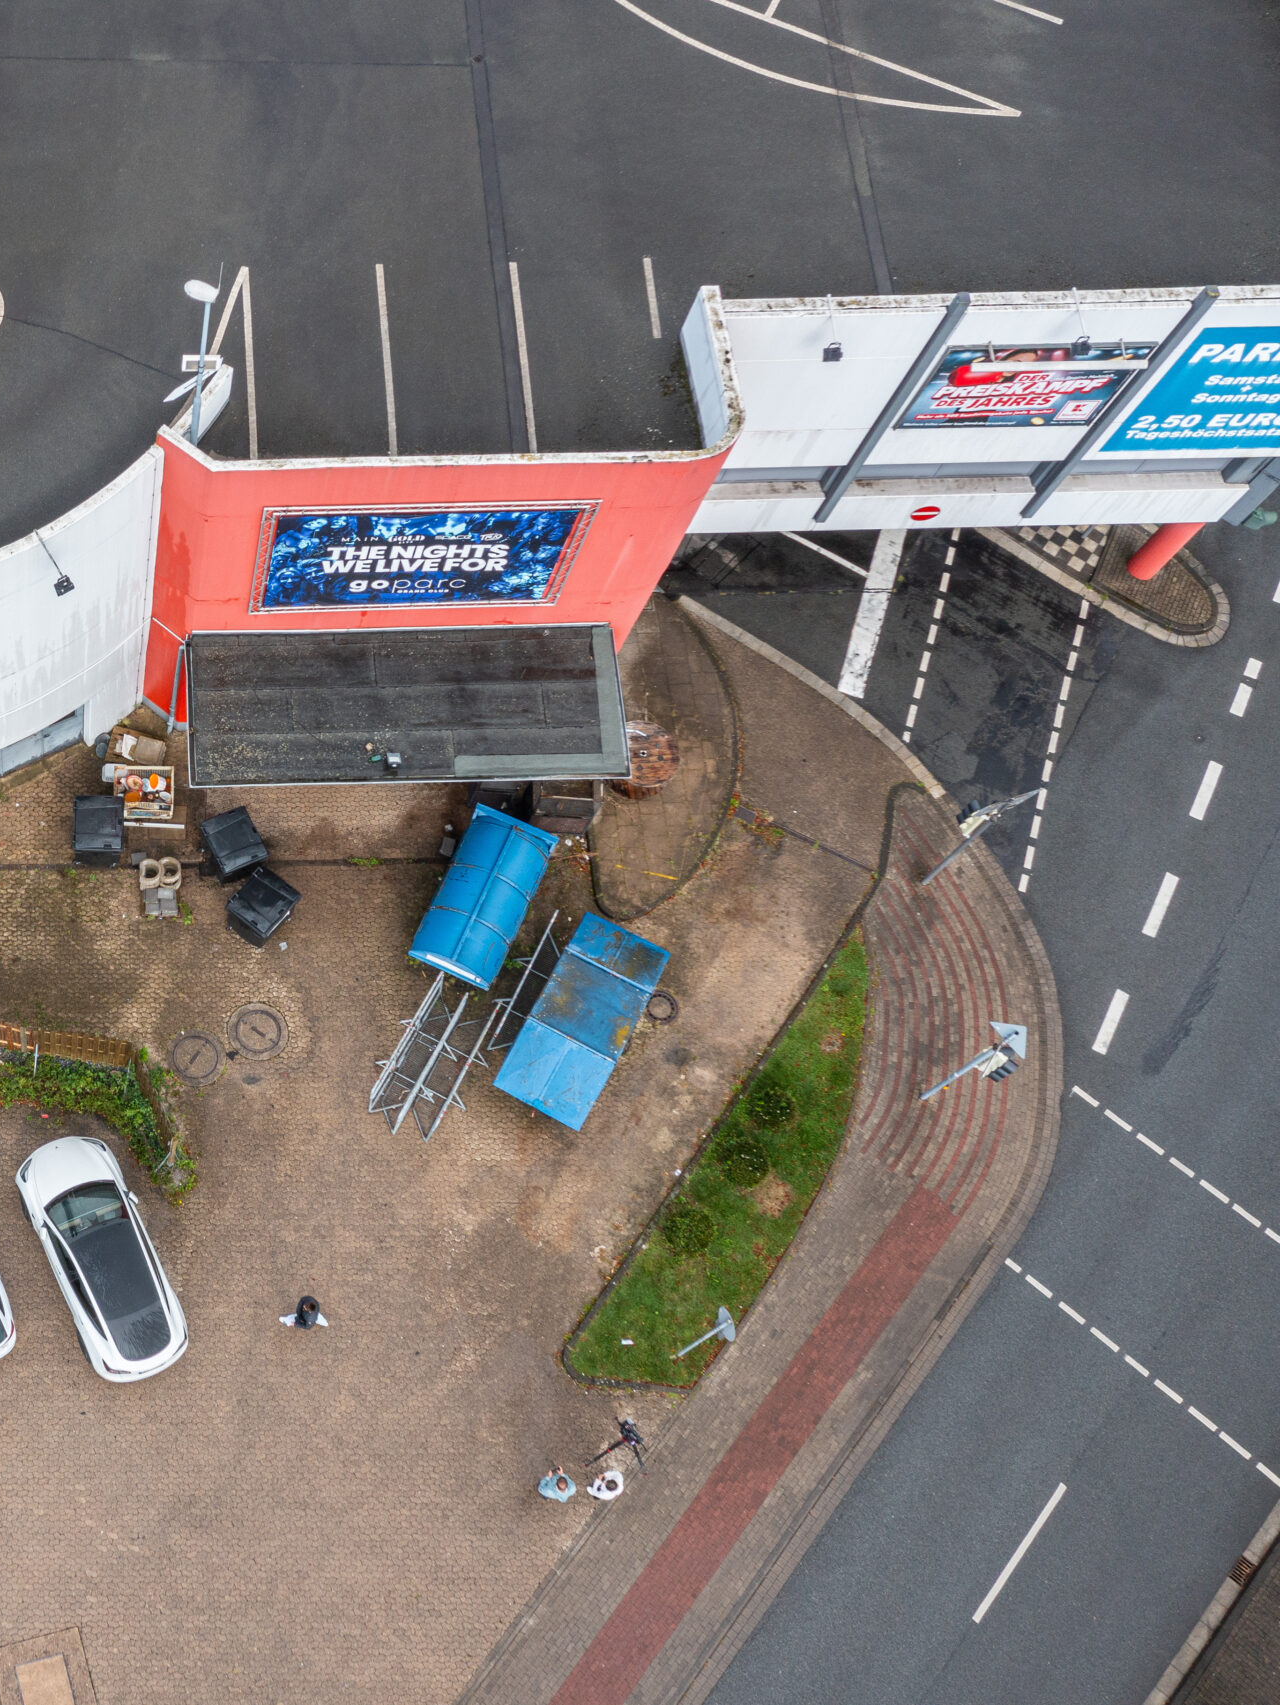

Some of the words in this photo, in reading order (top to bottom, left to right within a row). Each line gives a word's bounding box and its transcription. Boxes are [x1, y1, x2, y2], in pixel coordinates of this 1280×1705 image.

[1188, 342, 1280, 363] PAR
[1018, 374, 1050, 382] DER
[932, 378, 1111, 399] PREISKAMPF
[935, 399, 966, 407] DES
[965, 395, 1055, 409] JAHRES
[1191, 391, 1280, 404] Sonntag
[1131, 414, 1203, 431] 2,50
[387, 534, 426, 542] GOLD
[326, 546, 387, 560] THE
[389, 544, 510, 559] NIGHTS
[322, 560, 372, 574] WE
[375, 559, 441, 573] LIVE
[442, 558, 508, 572] FOR
[349, 578, 467, 594] goparc
